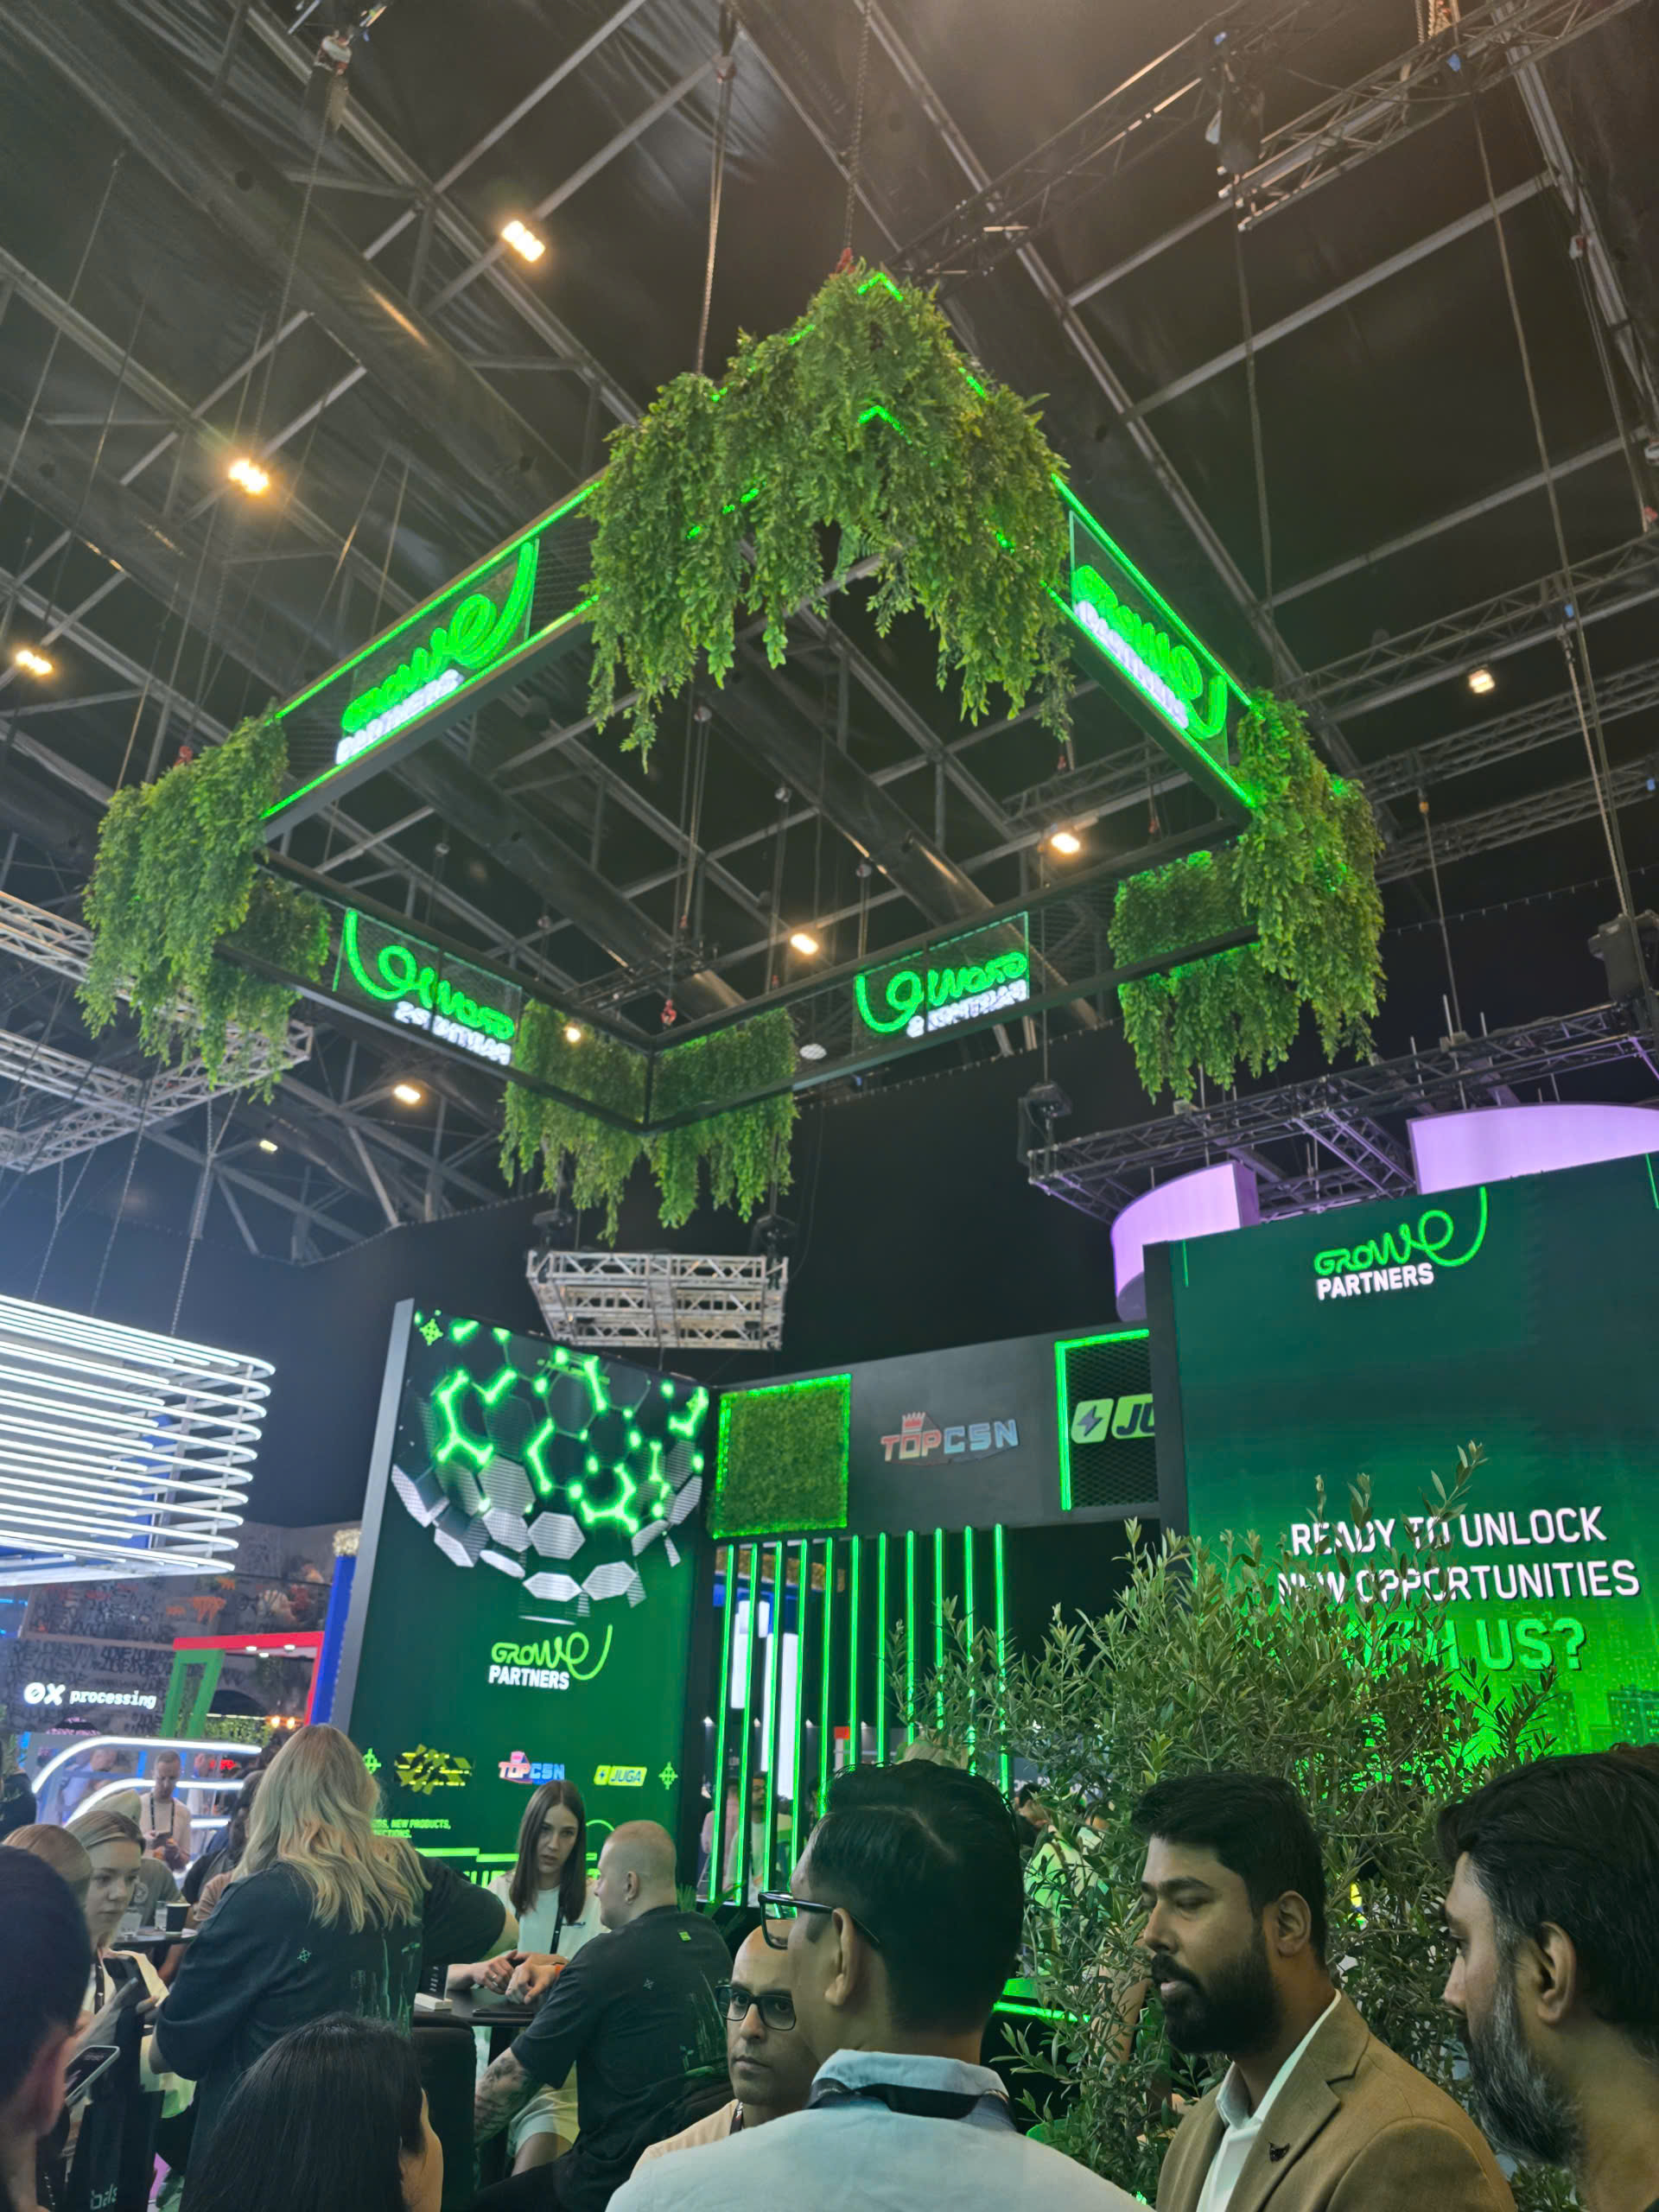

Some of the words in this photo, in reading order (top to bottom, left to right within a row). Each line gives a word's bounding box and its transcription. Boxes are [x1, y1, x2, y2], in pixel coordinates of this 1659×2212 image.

[1316, 1262, 1434, 1301] PARTNERS
[1291, 1518, 1395, 1555] READY
[1460, 1506, 1607, 1548] UNLOCK
[1355, 1559, 1641, 1604] OPPORTUNITIES
[488, 1664, 570, 1690] PARTNERS
[70, 1690, 157, 1709] processing
